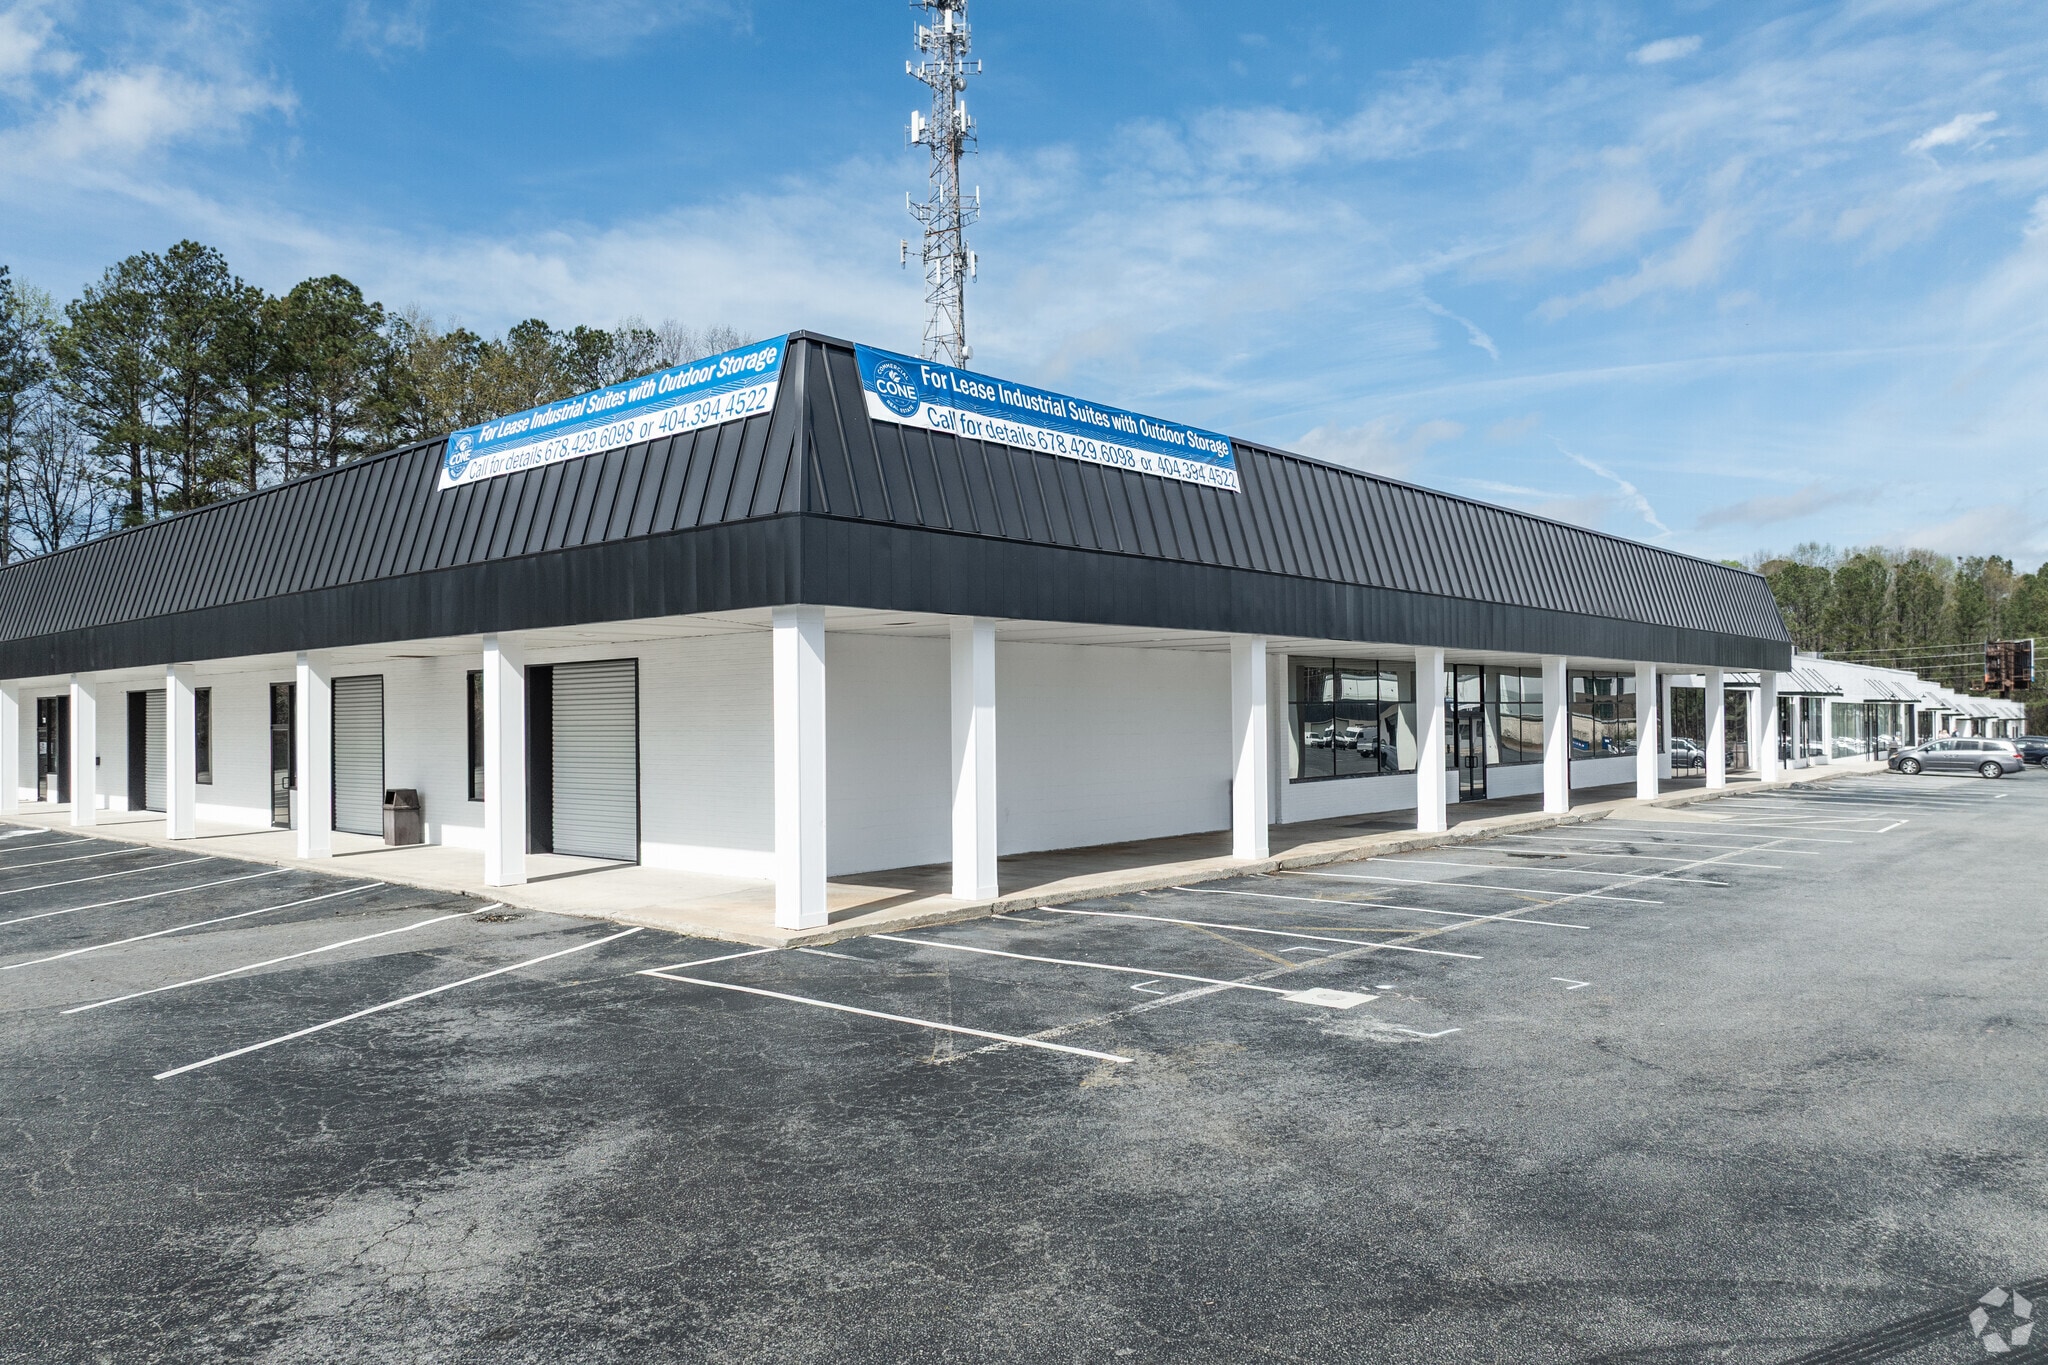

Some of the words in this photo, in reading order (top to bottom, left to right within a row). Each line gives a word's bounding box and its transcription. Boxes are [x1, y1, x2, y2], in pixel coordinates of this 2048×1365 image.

[479, 425, 496, 443] For
[498, 417, 530, 437] Lease
[530, 397, 587, 429] Industrial
[586, 389, 626, 414] Suites
[628, 379, 656, 403] with
[658, 364, 717, 394] Outdoor
[716, 346, 778, 378] Storage
[876, 379, 917, 400] CONE
[920, 364, 948, 390] For
[950, 371, 996, 401] Lease
[999, 383, 1067, 418] Industrial
[1068, 401, 1111, 428] Suites
[1111, 411, 1138, 435] with
[1139, 418, 1185, 446] Outdoor
[1186, 430, 1229, 458] Storage
[450, 450, 471, 466] CONE
[469, 457, 488, 480] Call
[489, 455, 504, 475] for
[505, 447, 543, 470] details
[544, 421, 635, 462] 678.429.6098
[639, 420, 655, 439] or
[659, 387, 768, 433] 404.394.4522
[927, 406, 955, 430] Call
[960, 413, 982, 435] for
[986, 422, 1036, 447] details
[1037, 430, 1136, 468] 678.429.6098
[1140, 456, 1153, 471] or
[1158, 456, 1237, 488] 404.394.4522
